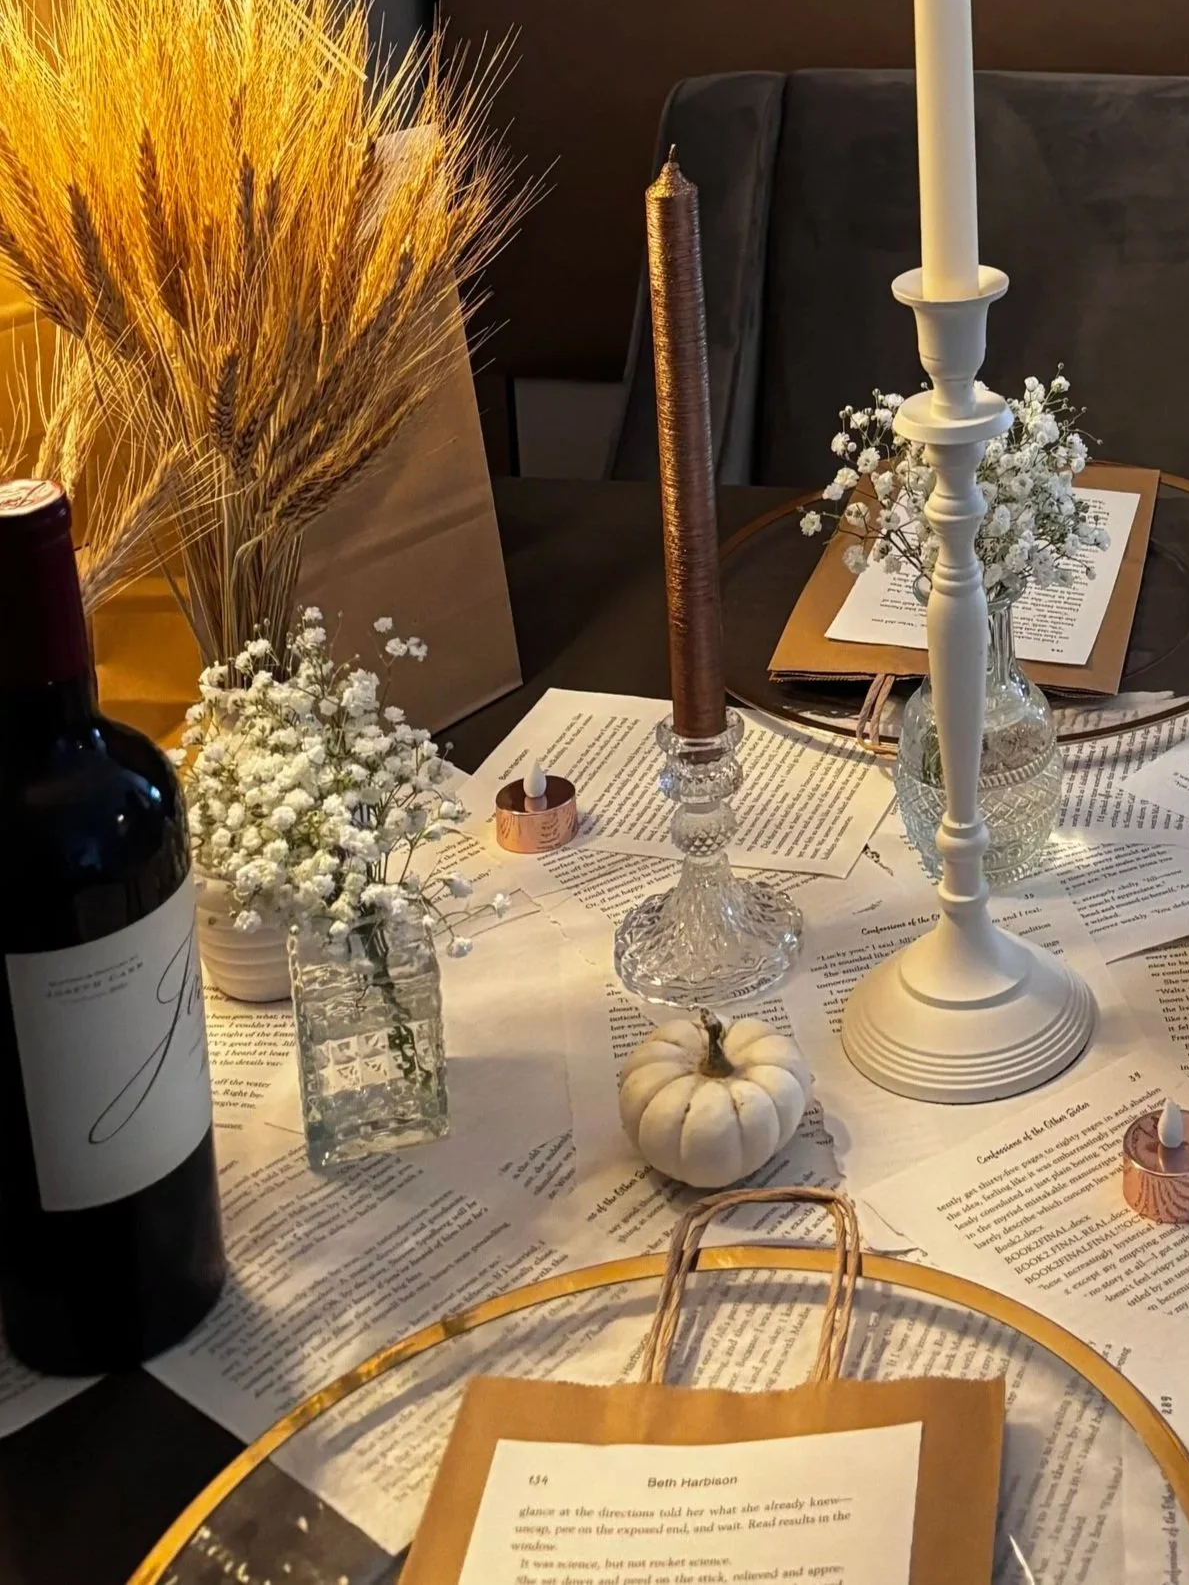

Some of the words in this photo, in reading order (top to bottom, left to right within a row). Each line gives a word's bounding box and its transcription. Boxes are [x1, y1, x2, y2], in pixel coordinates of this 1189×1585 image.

[860, 921, 907, 937] Confessions
[907, 917, 918, 928] of
[916, 915, 931, 925] the
[935, 1195, 964, 1213] tently
[963, 1187, 980, 1201] get
[977, 1165, 1021, 1191] thirty-five
[1020, 1152, 1048, 1170] pages
[1043, 1146, 1056, 1156] to
[1054, 1132, 1081, 1150] eighty
[1079, 1119, 1105, 1137] pages
[1102, 1114, 1115, 1124] in
[1113, 1103, 1131, 1119] and
[1128, 1086, 1163, 1110] abandon
[975, 1137, 1024, 1165] Confessions
[1021, 1130, 1034, 1142] of
[1029, 1125, 1047, 1137] the
[1042, 1113, 1069, 1130] Other
[1064, 1101, 1091, 1119] Sister
[964, 1231, 977, 1241] in
[975, 1222, 993, 1235] the
[992, 1203, 1025, 1226] myriad
[1023, 1181, 1069, 1210] mistakable
[1067, 1154, 1119, 1186] manuscripts
[1061, 1247, 1115, 1280] increasingly
[1111, 1222, 1156, 1251] hysterical
[518, 1505, 556, 1520] glance
[558, 1507, 571, 1518] at
[574, 1505, 596, 1519] the
[597, 1506, 656, 1519] directions
[658, 1505, 683, 1519] told
[685, 1506, 706, 1519] her
[708, 1504, 738, 1517] what
[739, 1502, 761, 1514] she
[763, 1496, 807, 1513] already
[646, 1476, 678, 1489] Beth
[680, 1475, 739, 1489] Harbison
